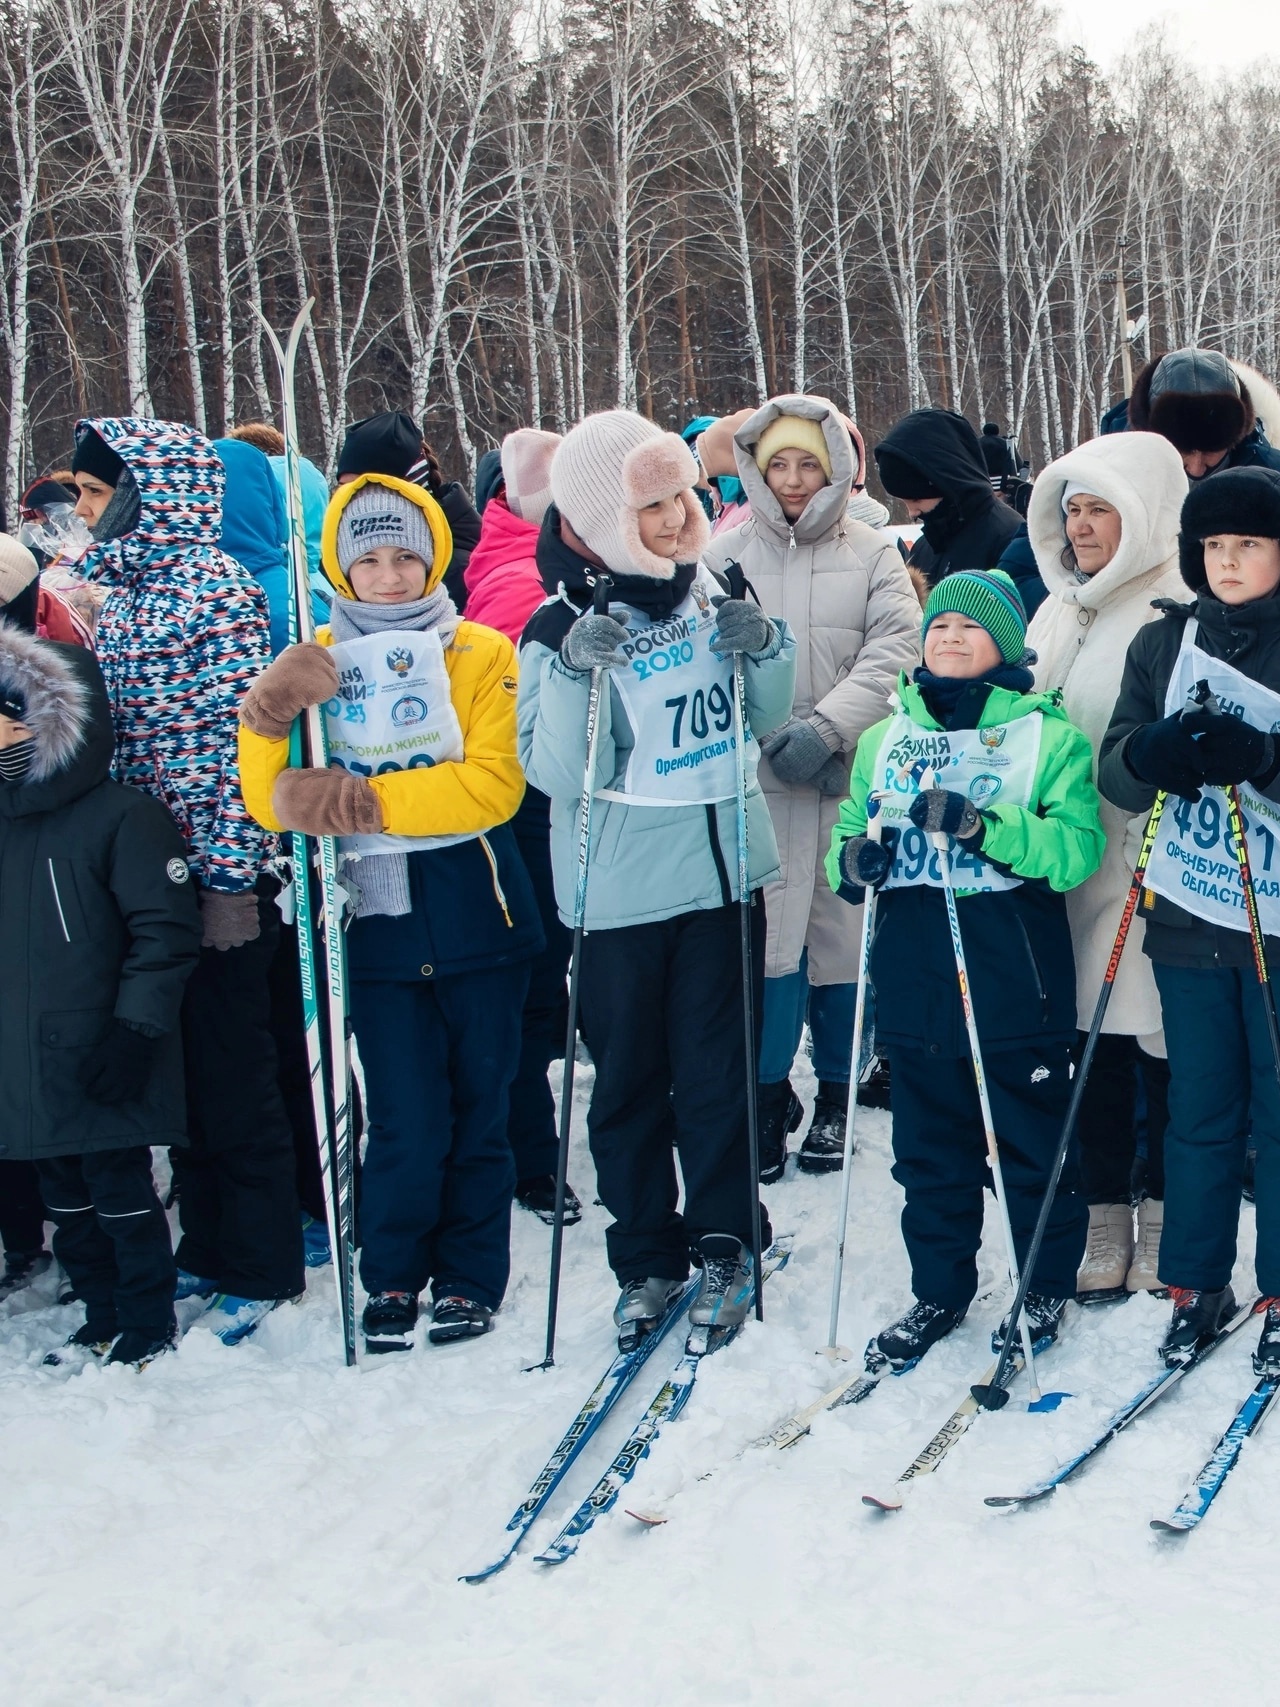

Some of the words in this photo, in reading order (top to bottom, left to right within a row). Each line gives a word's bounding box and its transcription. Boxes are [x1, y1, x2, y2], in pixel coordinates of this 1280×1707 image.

[350, 514, 403, 531] Prada
[353, 523, 405, 539] Milano
[622, 622, 690, 660] РОССИИ
[632, 641, 694, 681] 2020
[665, 674, 735, 748] 709
[395, 731, 442, 750] ЖИЗНИ
[656, 741, 729, 776] Оренбургская
[1173, 796, 1274, 872] 4981
